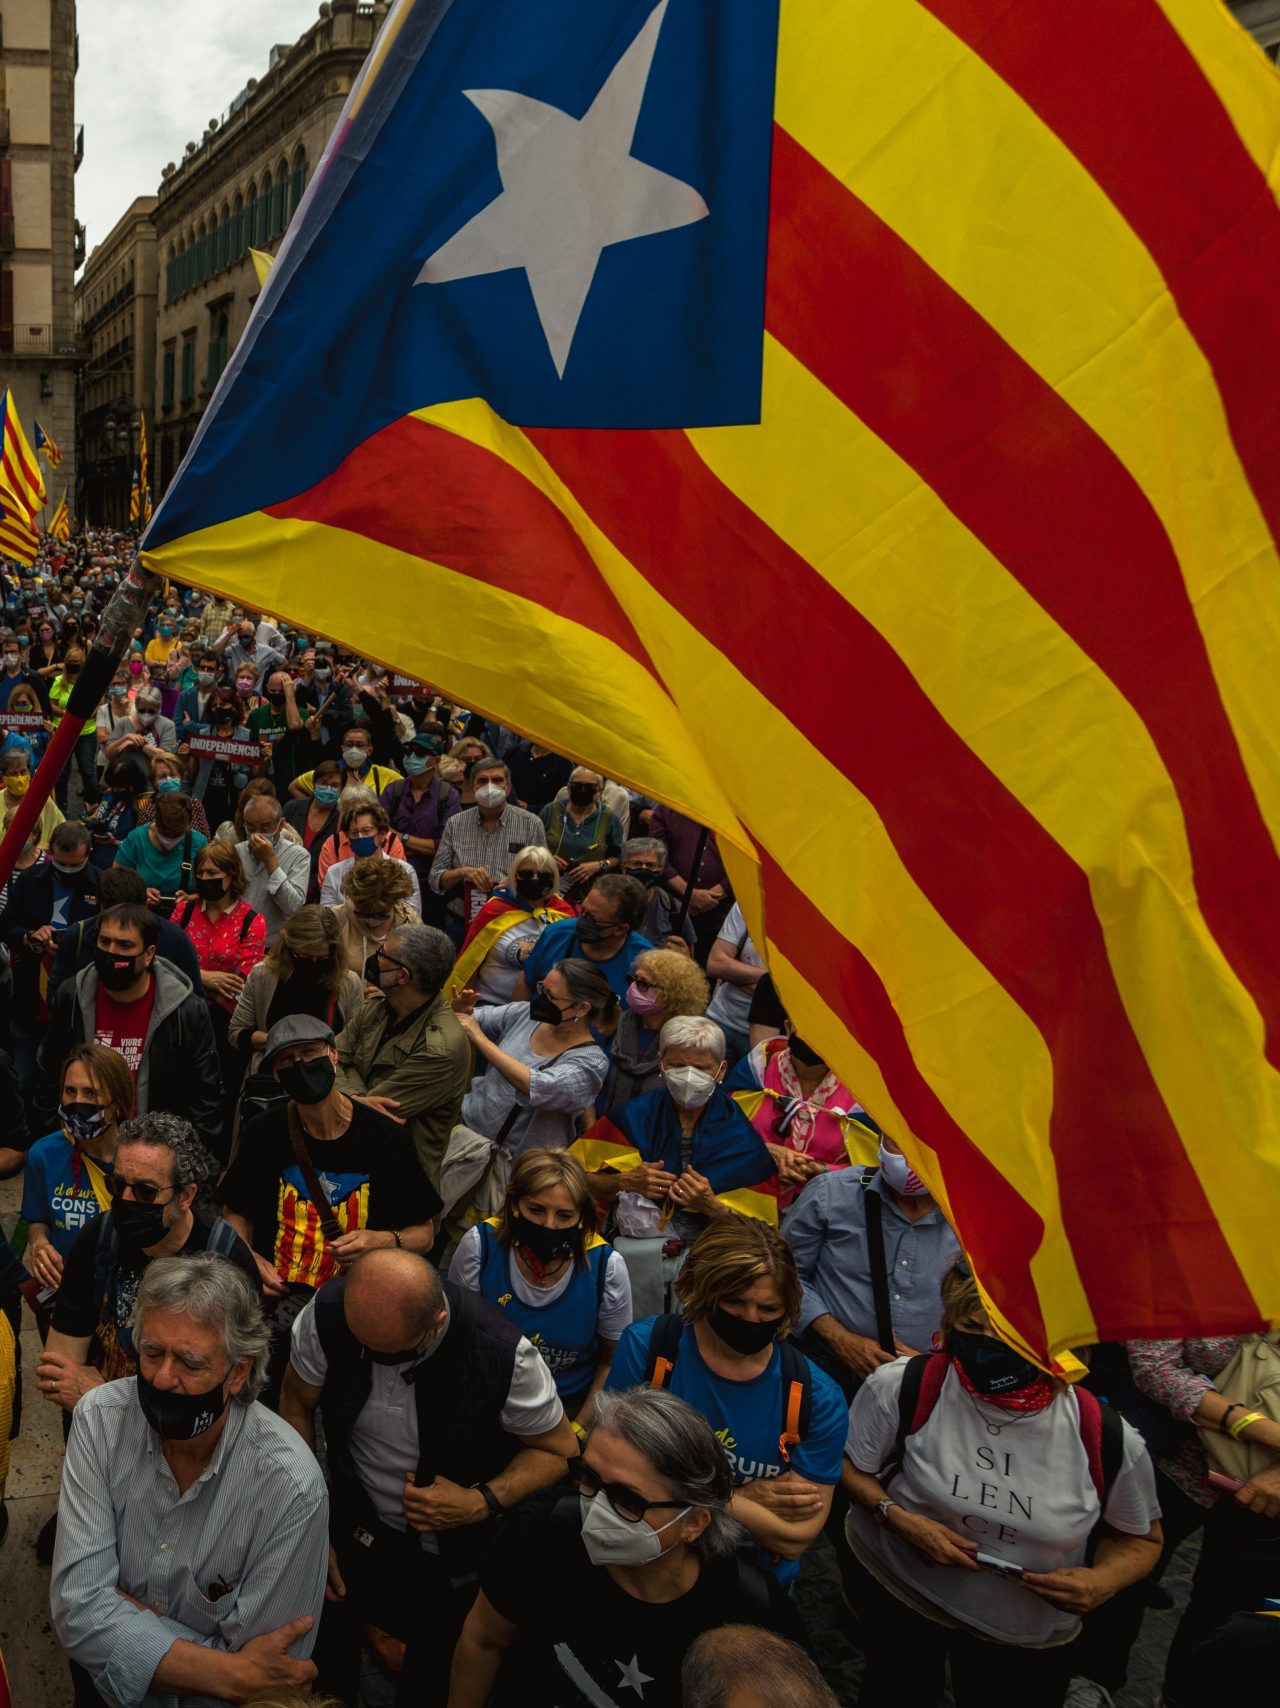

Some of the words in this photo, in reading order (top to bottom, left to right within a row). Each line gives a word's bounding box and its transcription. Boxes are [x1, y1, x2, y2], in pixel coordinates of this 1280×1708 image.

[189, 736, 261, 758] INDEPENDÈNCIA
[714, 1428, 738, 1450] de
[976, 1446, 1012, 1477] SI
[950, 1474, 1033, 1521] LEN
[962, 1514, 1018, 1546] CE
